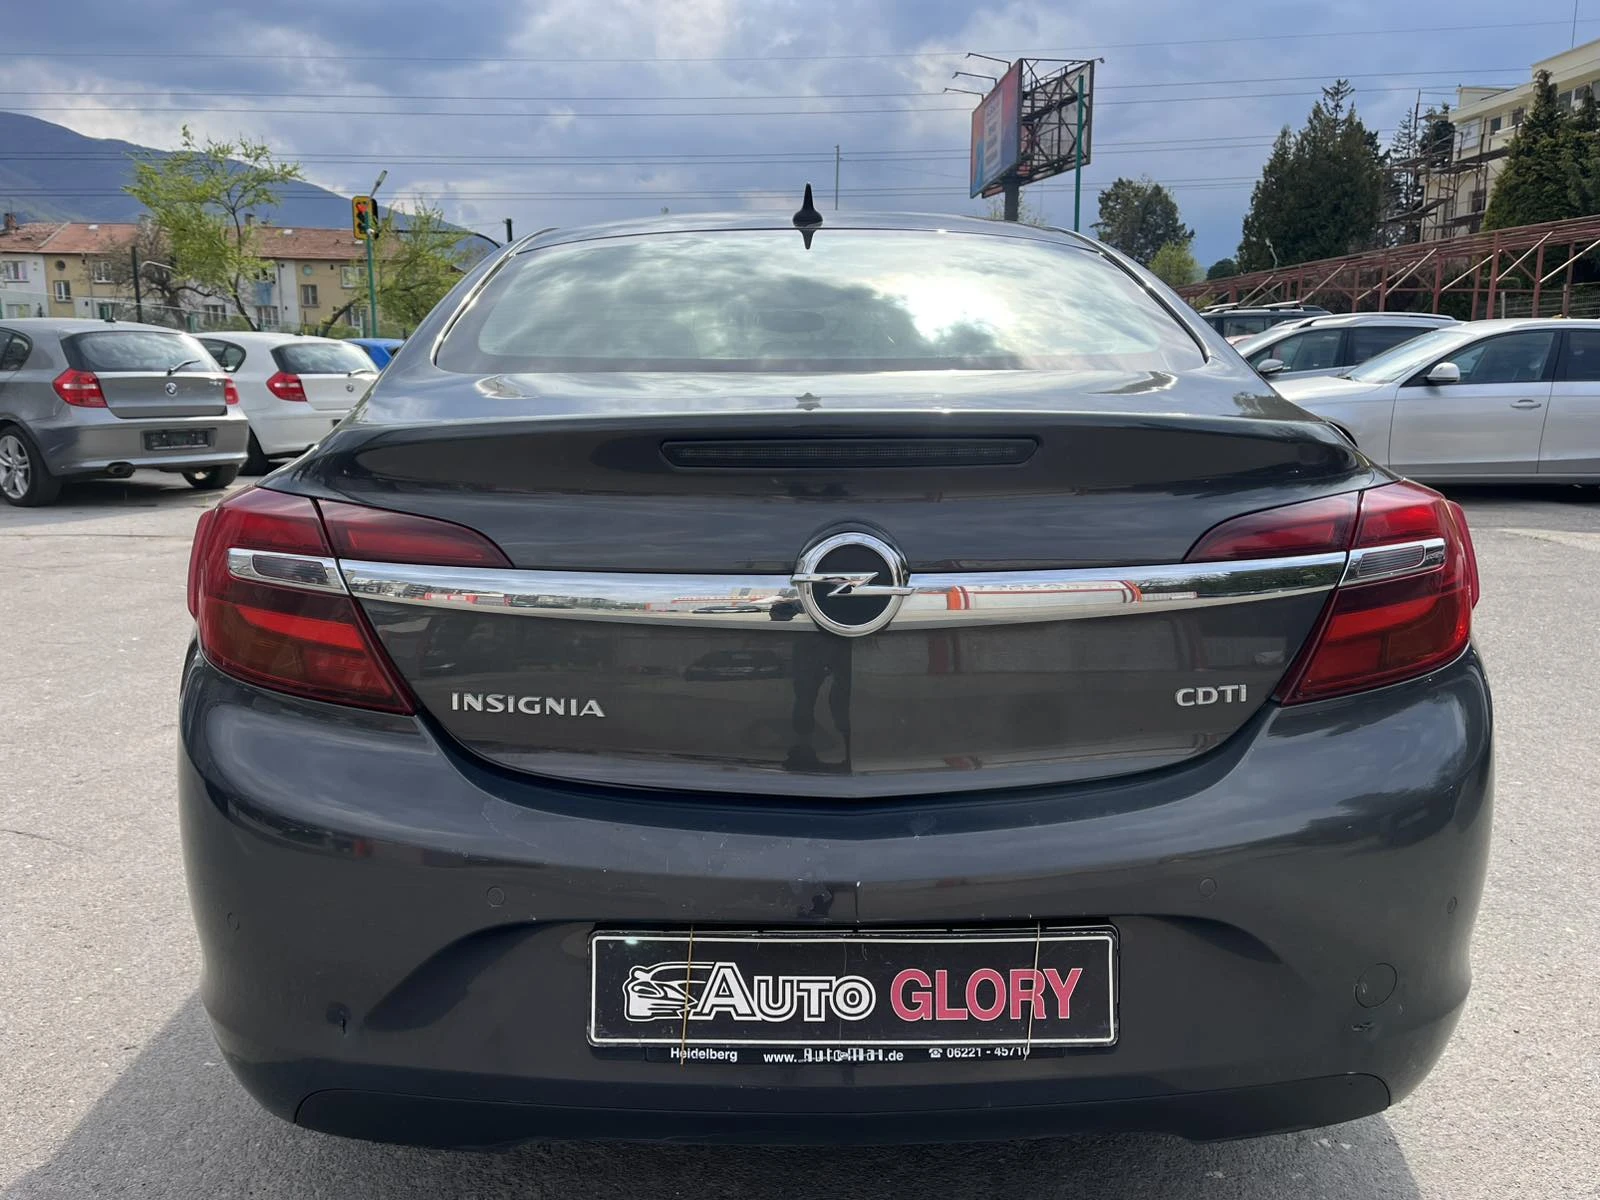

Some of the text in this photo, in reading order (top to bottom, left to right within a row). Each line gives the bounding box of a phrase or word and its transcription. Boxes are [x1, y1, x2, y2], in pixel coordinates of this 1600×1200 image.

[451, 692, 606, 718] INSIGNIA
[1175, 684, 1247, 707] CDTI
[890, 967, 1083, 1021] GLORY
[670, 1047, 738, 1062] Heidelberg
[946, 1047, 982, 1058] 06221
